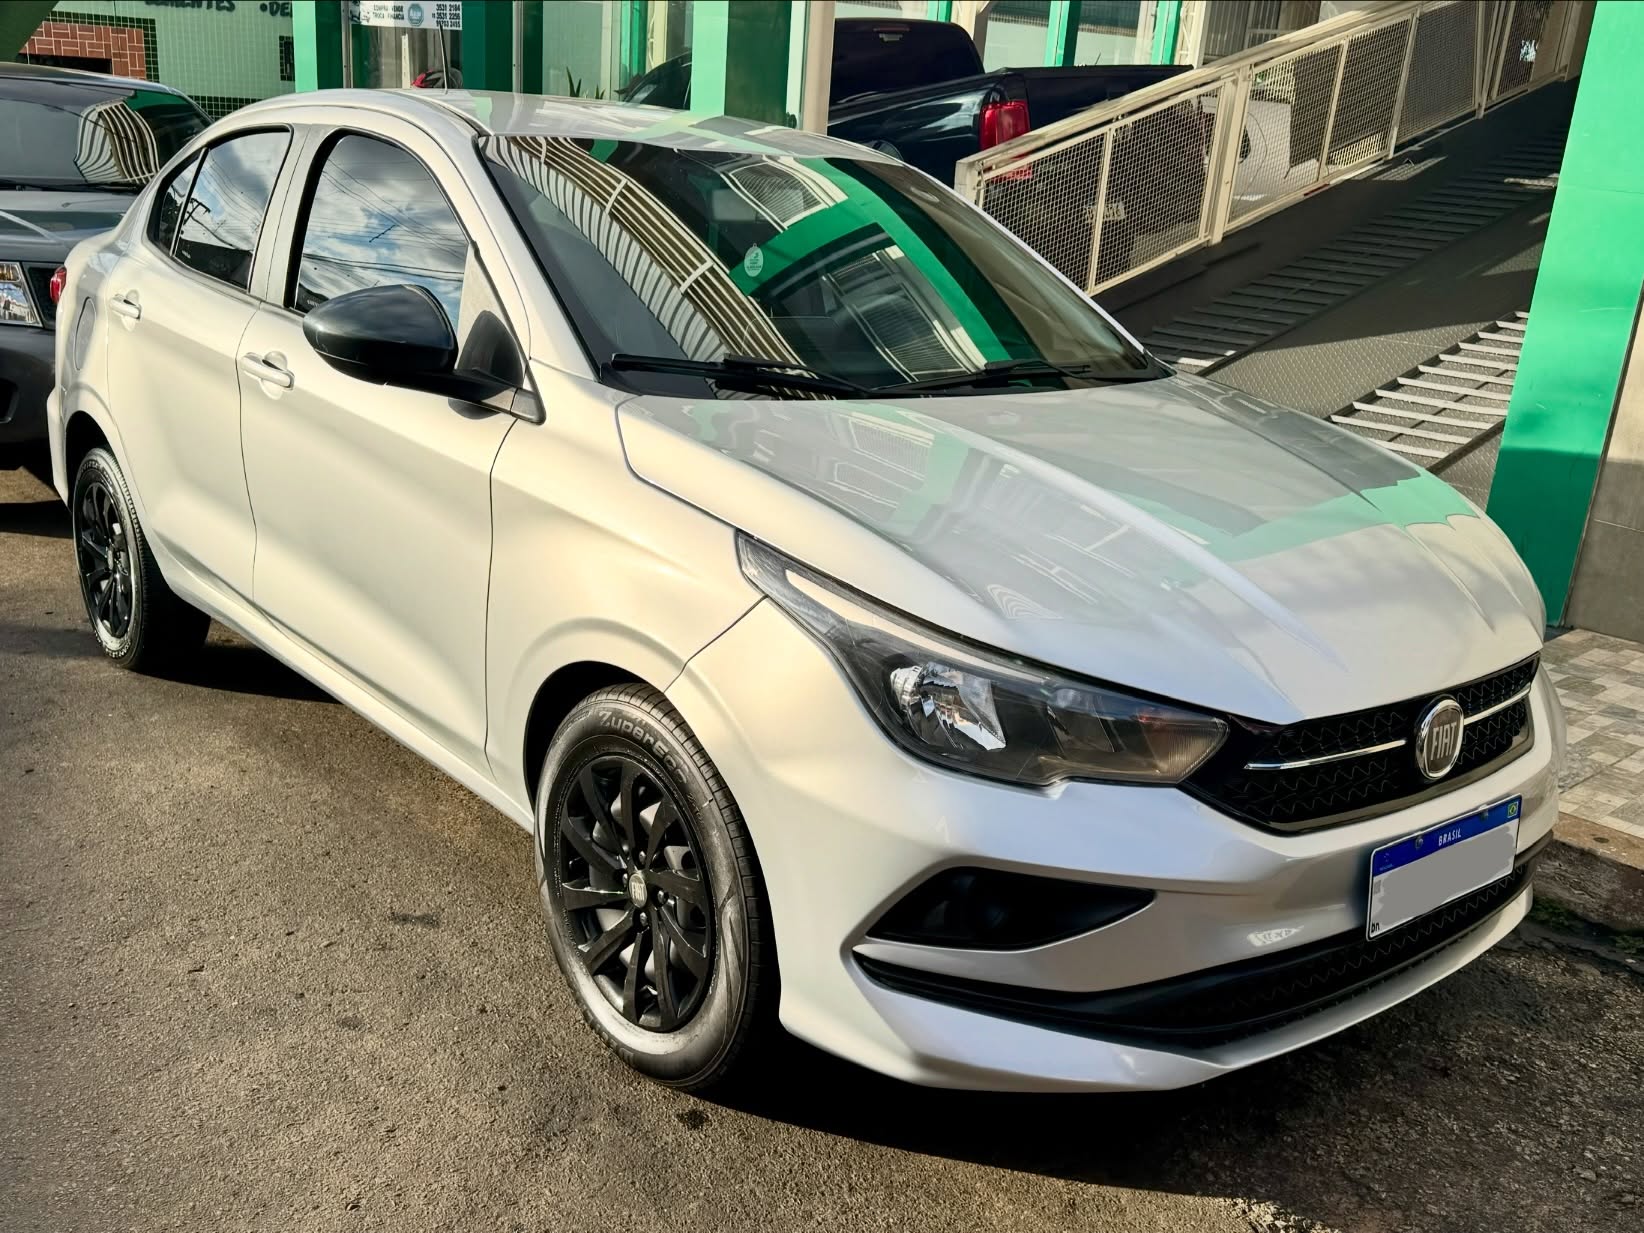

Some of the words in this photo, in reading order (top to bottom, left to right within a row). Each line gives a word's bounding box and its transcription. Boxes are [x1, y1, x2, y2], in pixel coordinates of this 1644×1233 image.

[269, 2, 292, 17] DE
[1430, 722, 1457, 761] FIAT
[1438, 828, 1462, 846] BRASIL
[631, 882, 645, 902] FIAT
